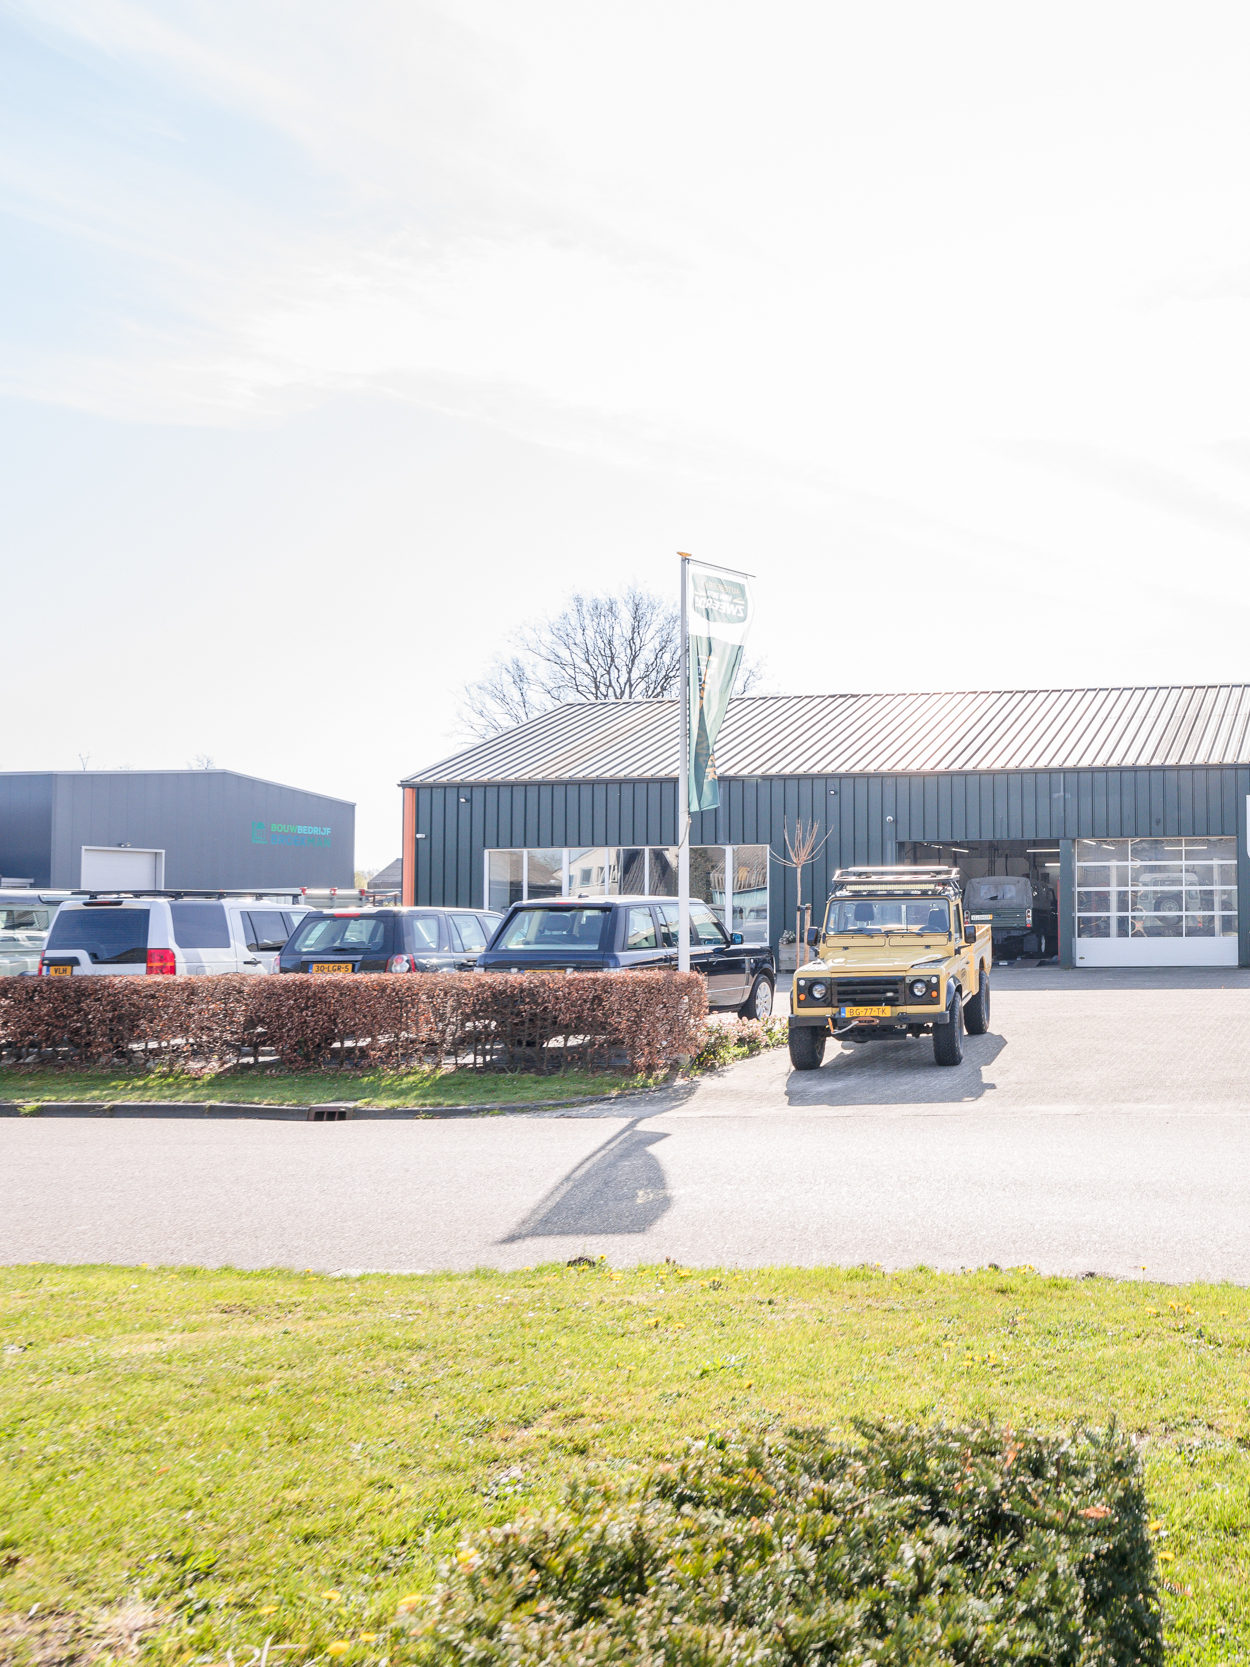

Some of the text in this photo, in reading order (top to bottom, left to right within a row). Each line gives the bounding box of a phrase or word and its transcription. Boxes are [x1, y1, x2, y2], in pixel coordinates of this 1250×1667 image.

[270, 823, 332, 836] BOUWBEDRIJF
[270, 834, 332, 848] BROEKMAN
[53, 967, 68, 975] VLH
[849, 1007, 887, 1016] BG-77-TK
